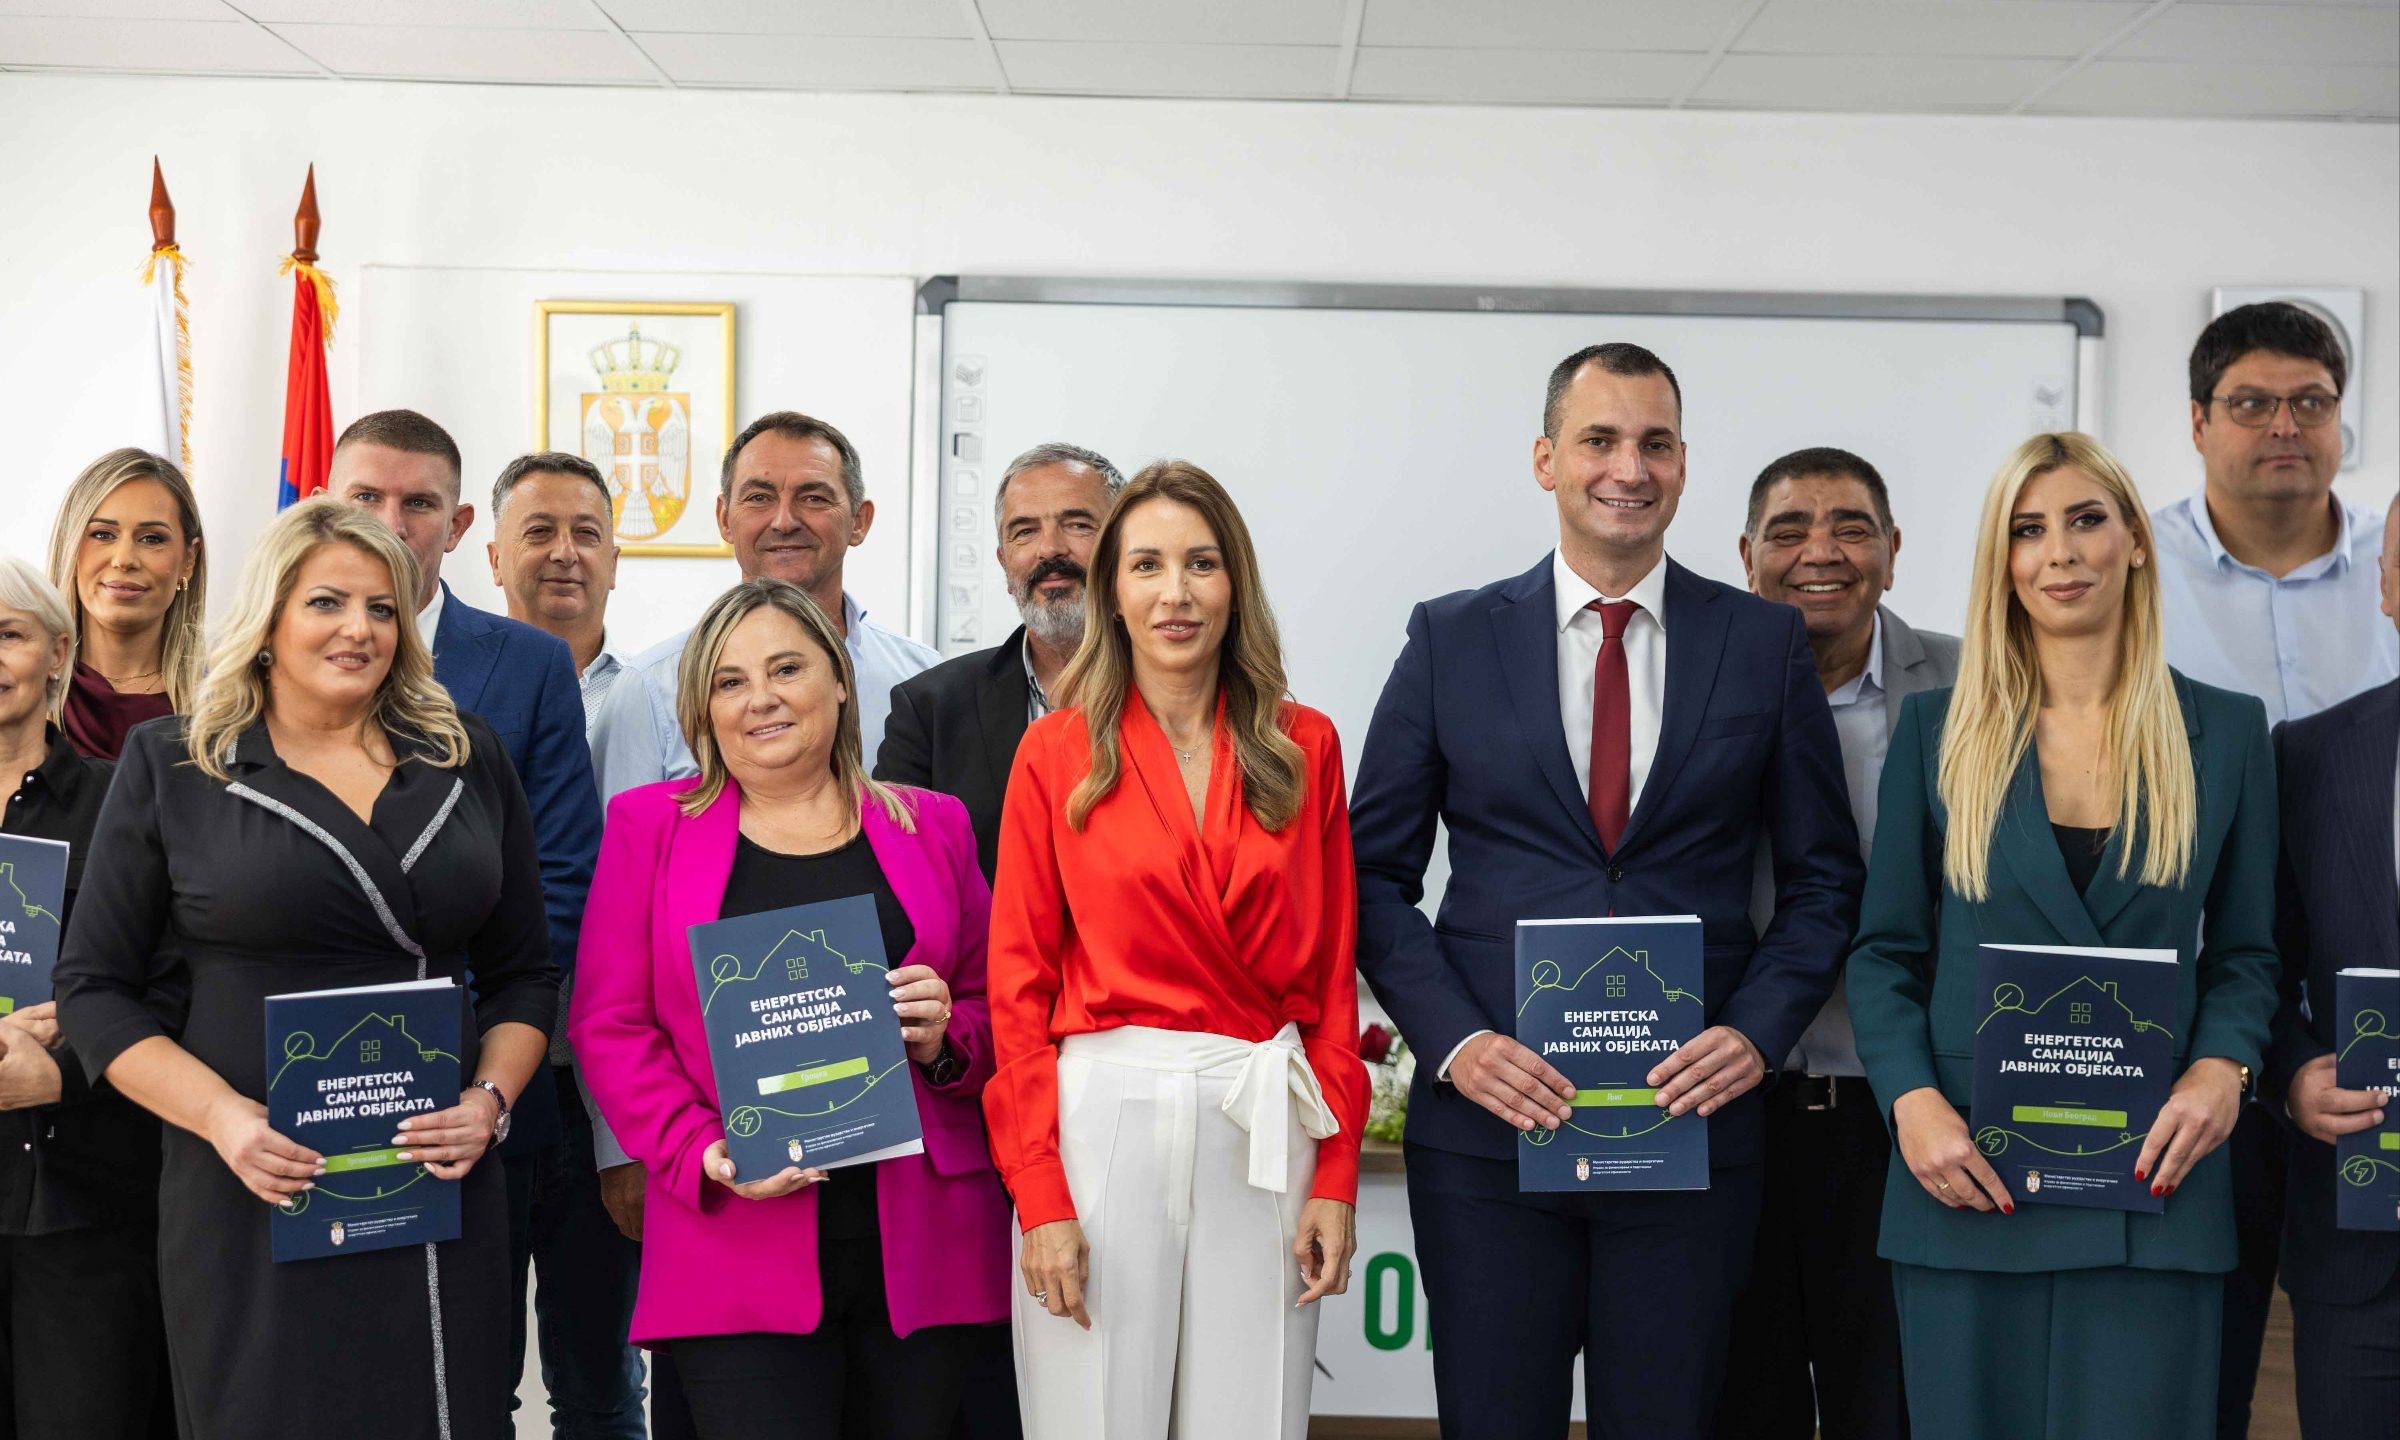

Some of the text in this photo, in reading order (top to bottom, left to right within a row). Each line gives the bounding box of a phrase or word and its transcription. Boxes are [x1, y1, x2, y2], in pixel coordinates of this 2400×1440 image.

[750, 985, 846, 1012] ЕНЕРГЕТСКА
[761, 1001, 841, 1025] САНАЦИЈА
[1564, 1010, 1659, 1023] ЕНЕРГЕТСКА
[735, 1009, 872, 1048] ЈАВНИХ ОБЈЕКАТА
[1572, 1025, 1651, 1039] САНАЦИЈА
[1543, 1039, 1680, 1055] ЈАВНИХ ОБЈЕКАТА
[2024, 1033, 2123, 1048] ЕНЕРГЕТСКА
[2032, 1048, 2114, 1063] САНАЦИЈА
[2000, 1060, 2144, 1077] ЈАВНИХ ОБЈЕКАТА
[317, 1070, 414, 1093] ЕНЕРГЕТСКА
[325, 1086, 406, 1105] САНАЦИЈА
[296, 1097, 435, 1127] ЈАВНИХ ОБЈЕКАТА
